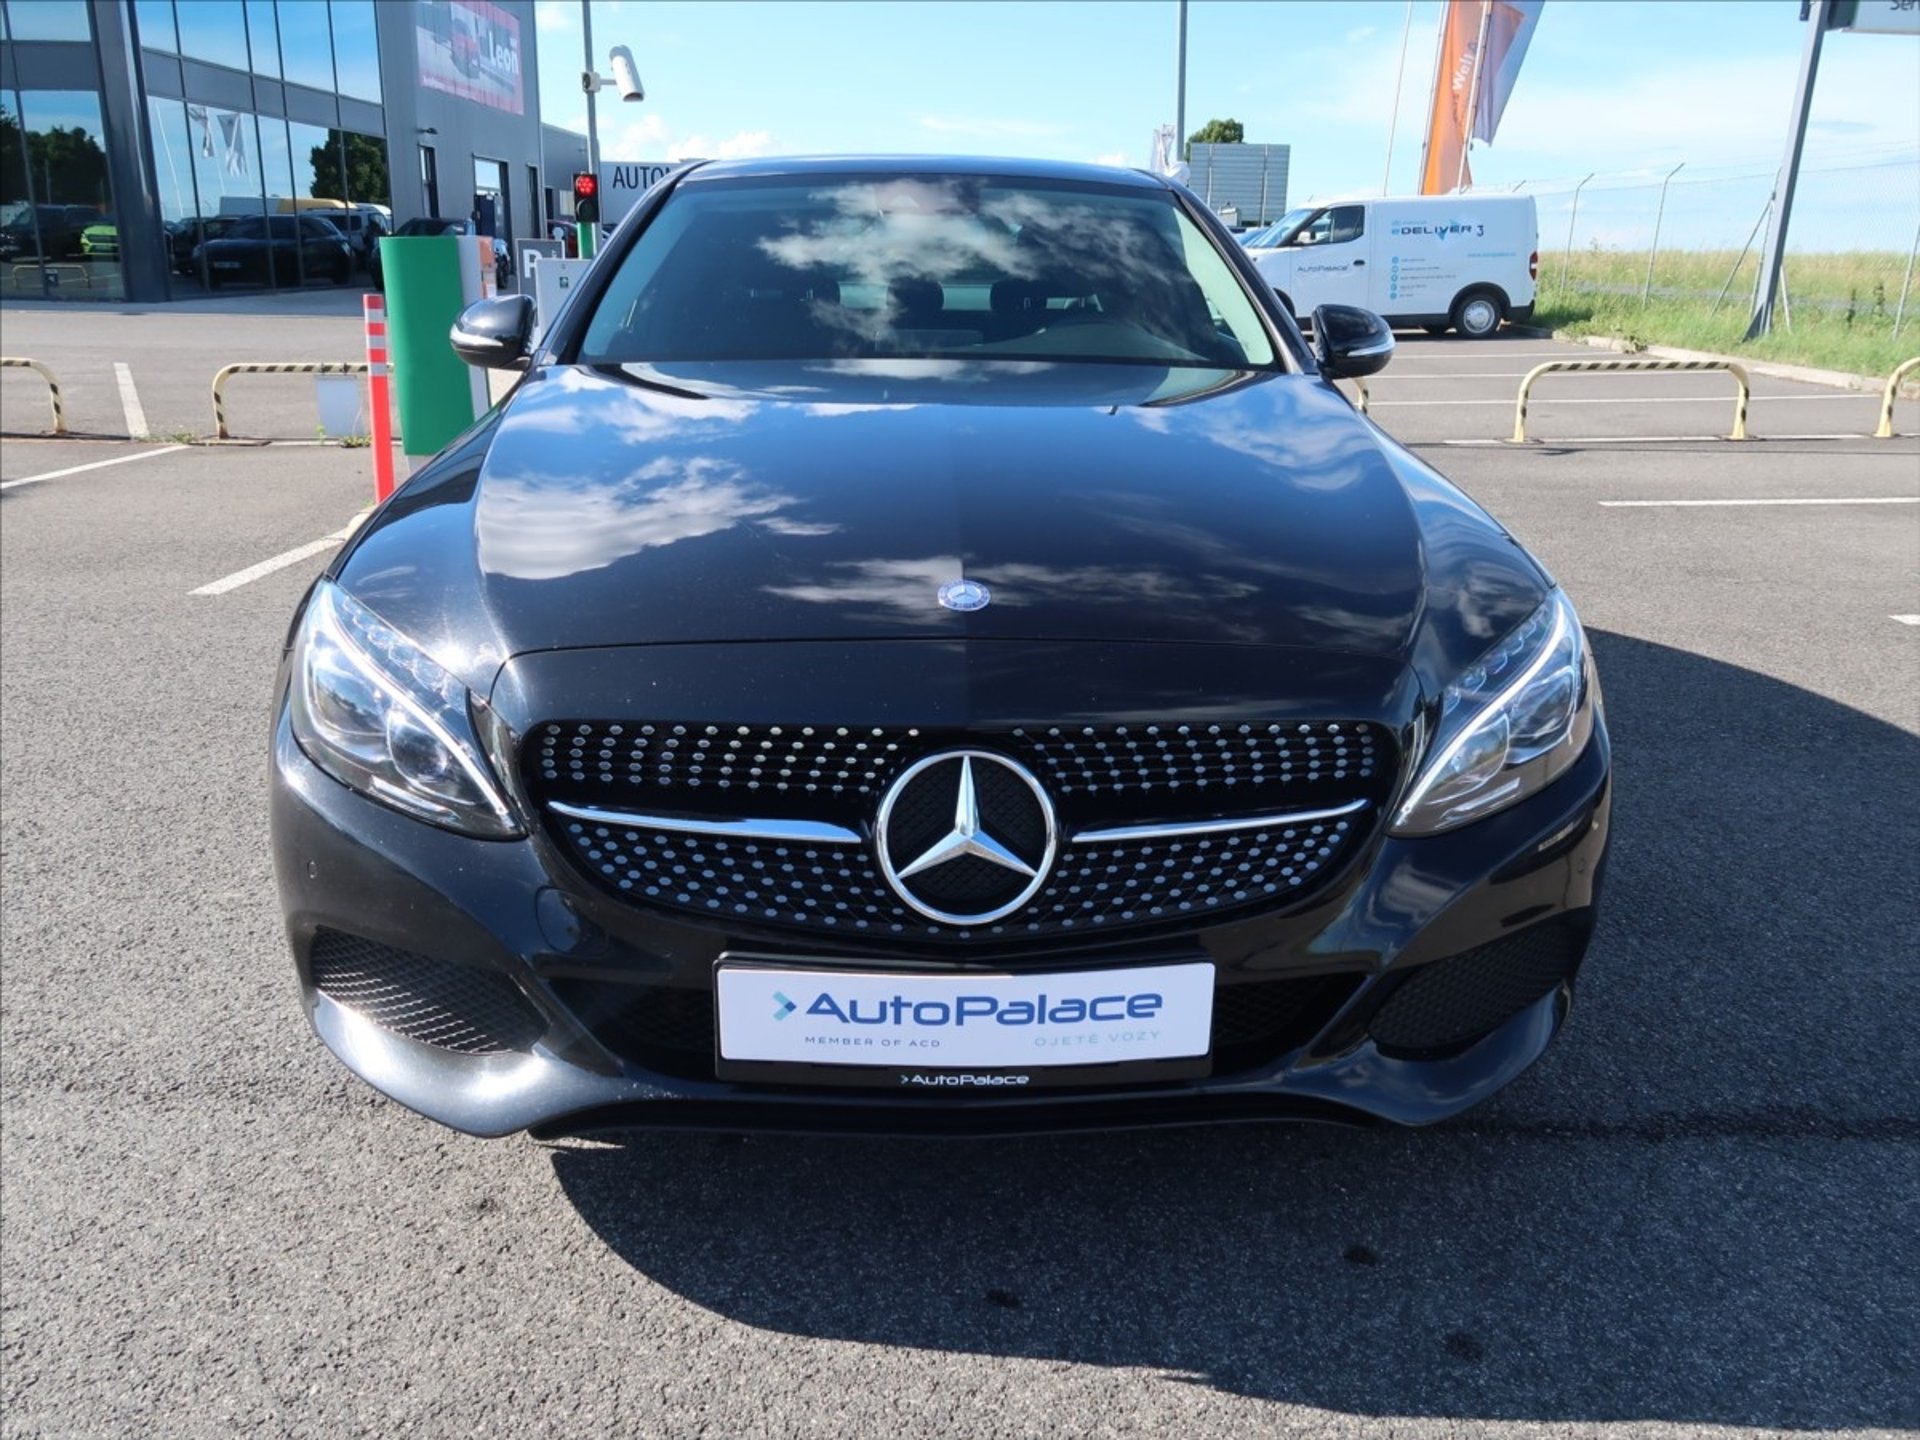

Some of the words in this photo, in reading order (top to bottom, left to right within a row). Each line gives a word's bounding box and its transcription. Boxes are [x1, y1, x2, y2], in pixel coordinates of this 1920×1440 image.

[488, 30, 519, 75] Leon
[612, 166, 671, 189] AUTO
[1476, 224, 1485, 238] 3
[806, 992, 1163, 1026] AutoPalace
[804, 1036, 873, 1046] MEMBER
[881, 1039, 901, 1047] OF
[908, 1039, 941, 1048] ACD
[1107, 1030, 1160, 1043] VOZY
[911, 1074, 1030, 1086] AutoPalace
